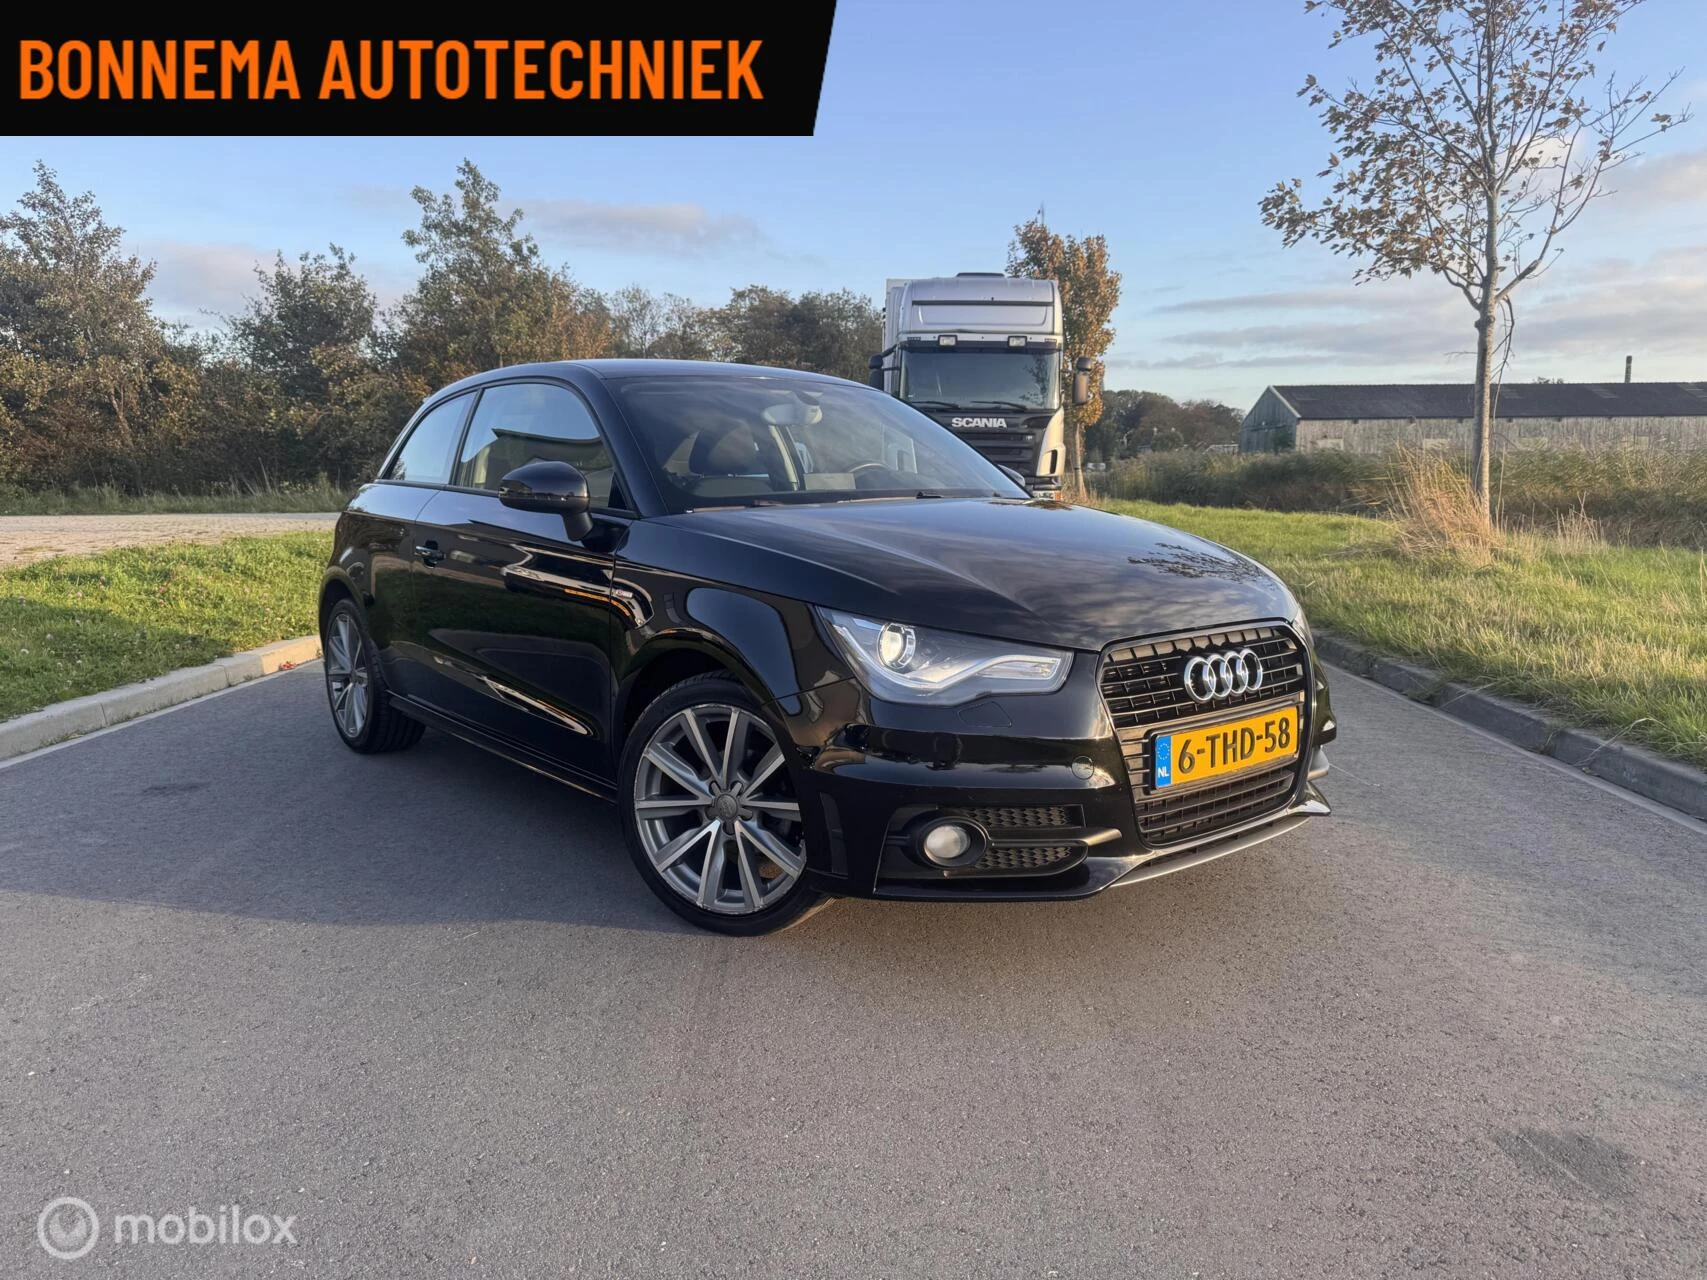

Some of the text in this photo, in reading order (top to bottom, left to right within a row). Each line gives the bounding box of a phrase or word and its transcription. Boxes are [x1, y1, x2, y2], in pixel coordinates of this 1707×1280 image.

[952, 417, 1007, 428] SCANIA
[1178, 717, 1291, 774] 6-THD-58
[1158, 766, 1170, 778] NL
